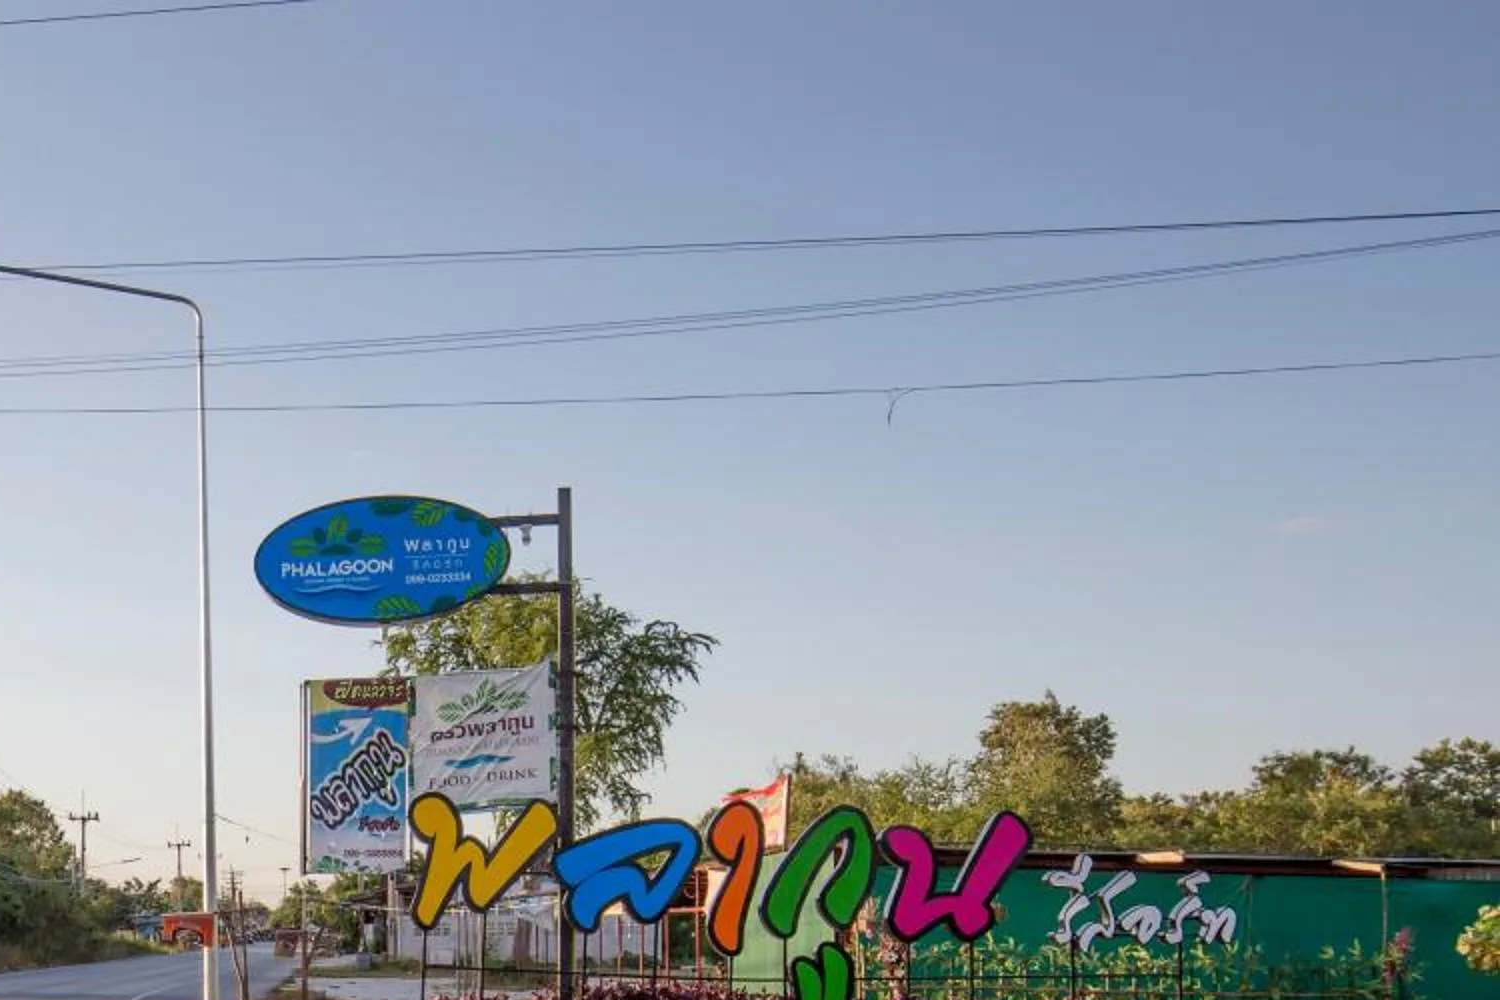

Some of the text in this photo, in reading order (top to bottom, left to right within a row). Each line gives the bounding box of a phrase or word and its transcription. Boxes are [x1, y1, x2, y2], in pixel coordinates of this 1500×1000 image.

[281, 558, 394, 579] PHALAGOON
[311, 730, 405, 830] พลากูน
[486, 767, 538, 783] DRINK
[1041, 853, 1237, 952] รีสอร์ท
